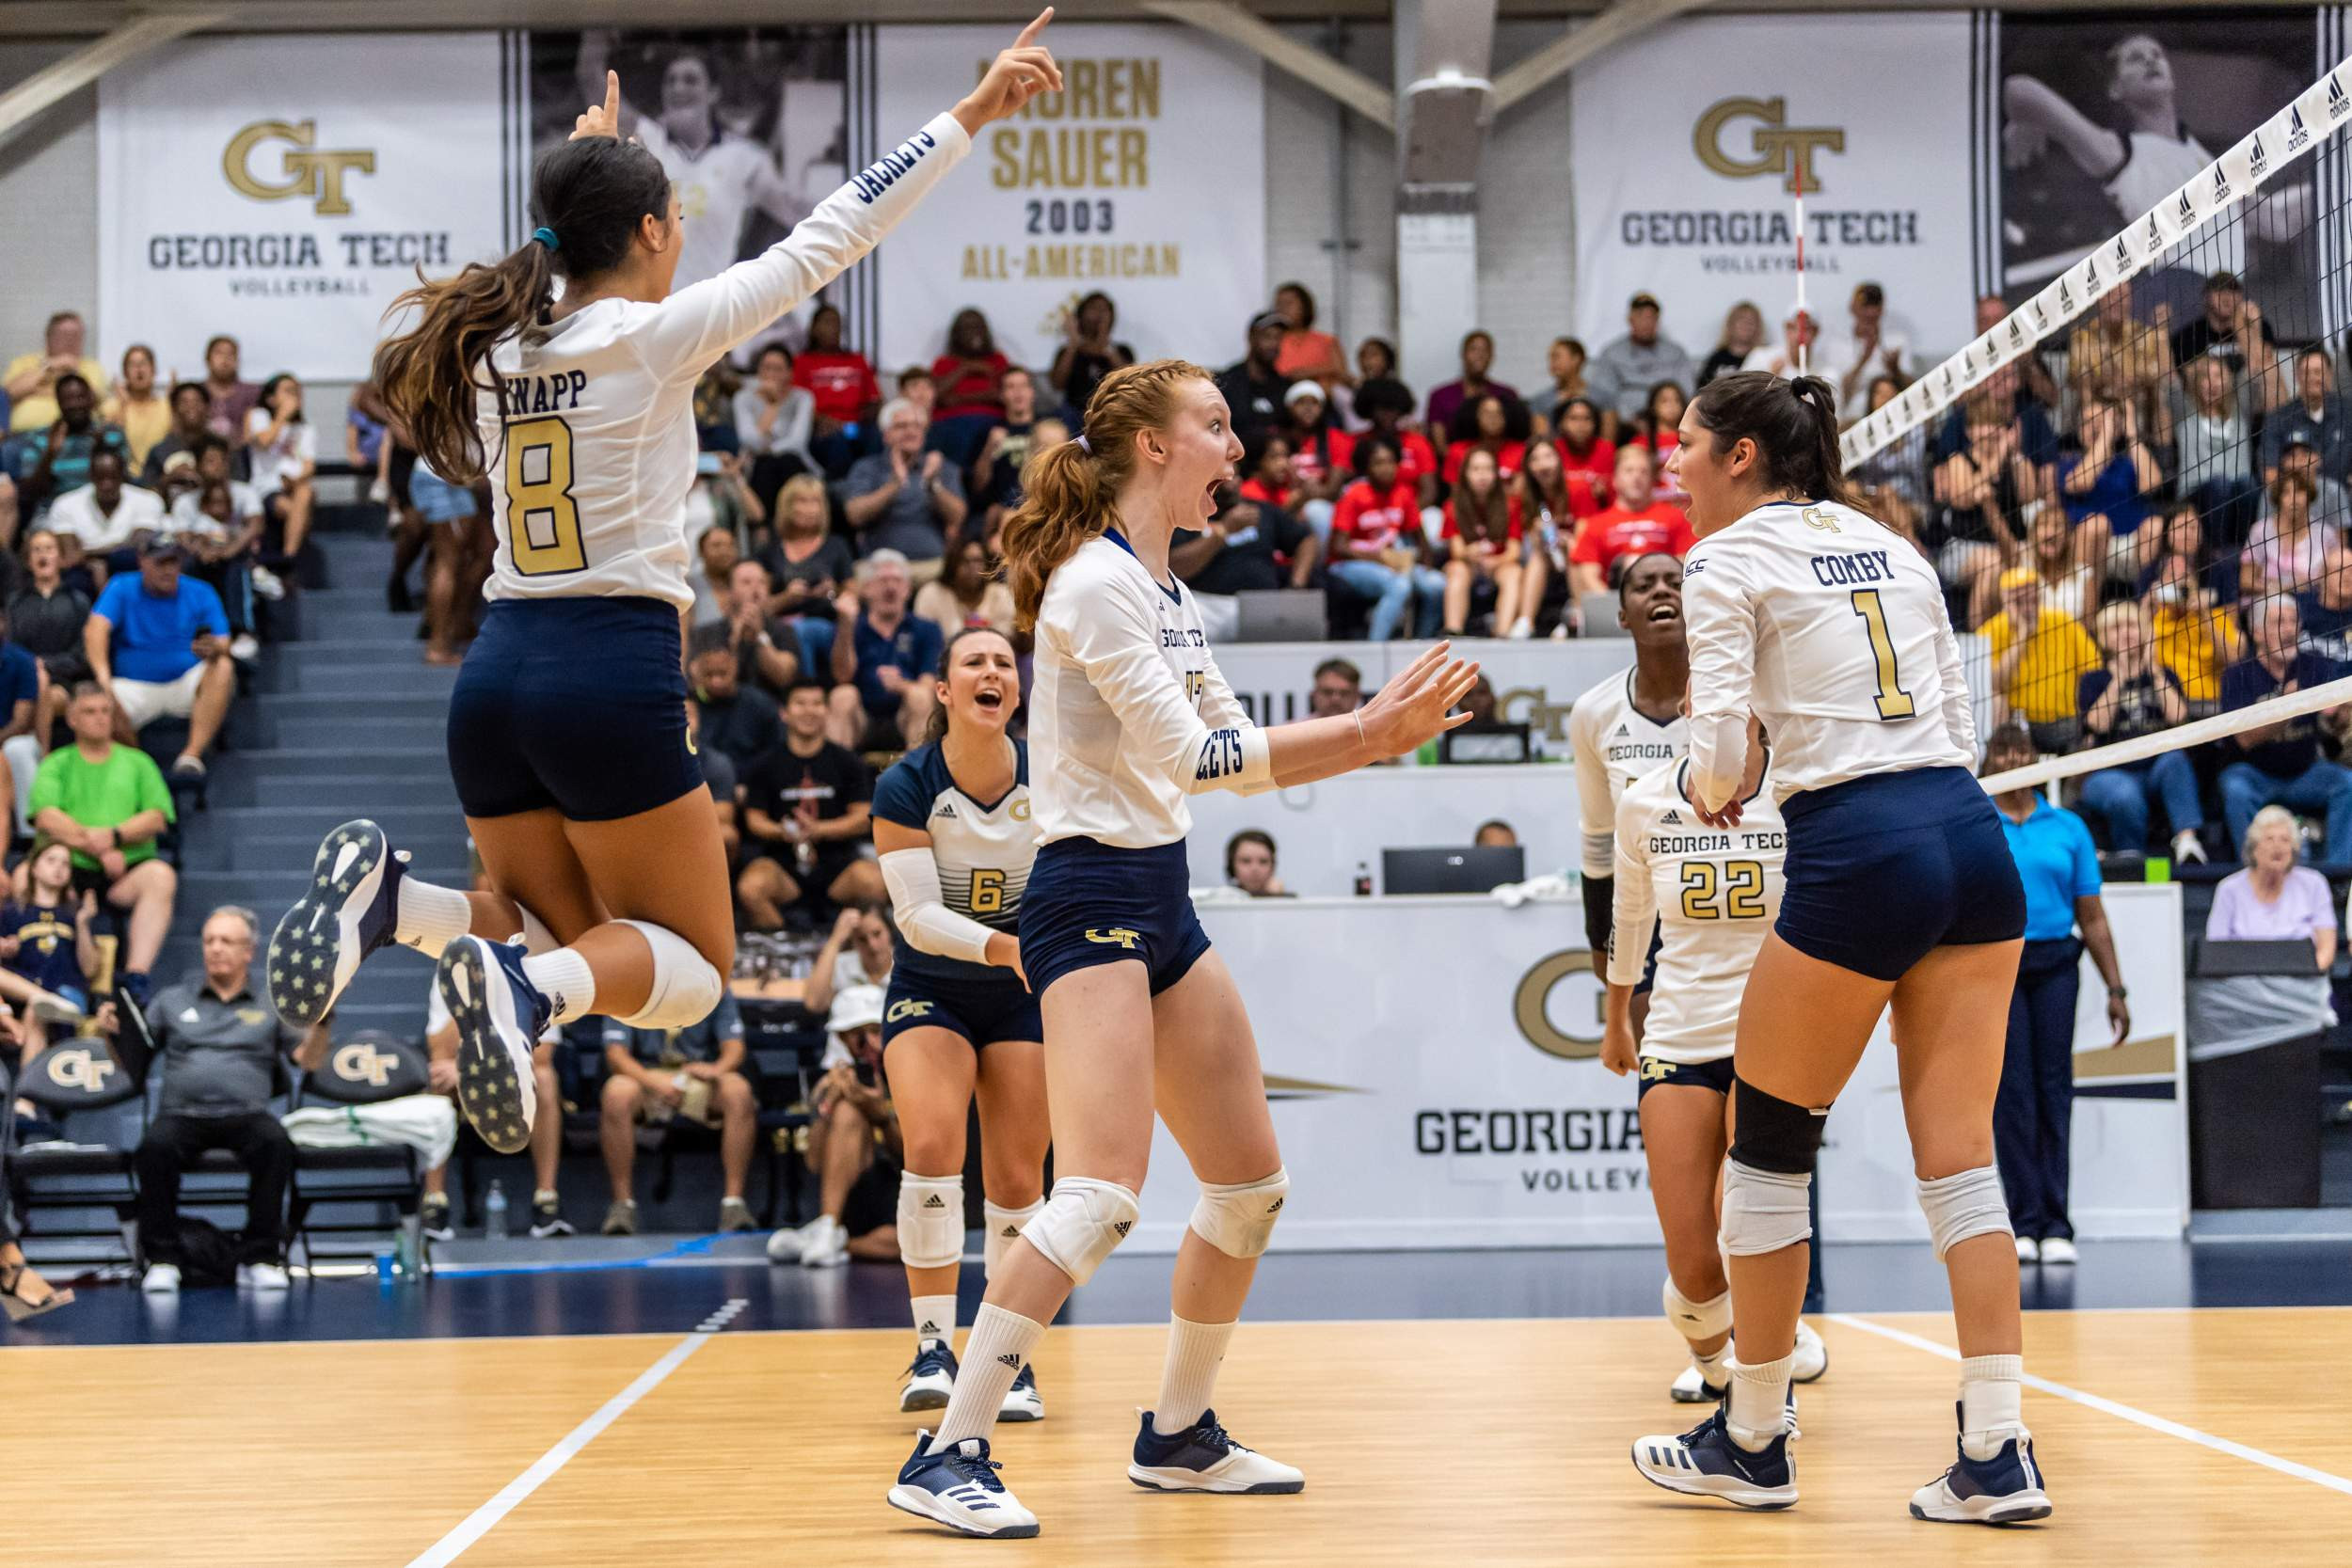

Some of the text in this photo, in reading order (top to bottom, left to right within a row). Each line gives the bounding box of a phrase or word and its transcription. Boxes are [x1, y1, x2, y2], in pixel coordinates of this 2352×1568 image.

[977, 58, 1161, 119] UREN
[2328, 97, 2350, 119] adidas
[991, 128, 1148, 188] SAUER
[1692, 95, 1846, 192] GT
[221, 119, 376, 215] GT
[1025, 198, 1114, 234] 2003
[1621, 210, 1917, 245] GEORGIA TECH
[148, 231, 451, 269] GEORGIA TECH
[961, 244, 1181, 279] ALL-AMERICAN
[229, 278, 372, 297] VOLLEYBALL
[505, 414, 588, 577] 8
[1802, 507, 1841, 533] GT
[1810, 550, 1896, 587] COMBY
[1851, 588, 1916, 721] 1
[1608, 744, 1674, 762] GEORGIA
[1009, 798, 1031, 822] G
[1649, 834, 1732, 854] GEORGIA
[969, 867, 1007, 914] 6
[1680, 860, 1766, 920] 22
[1513, 947, 1608, 1062] G
[47, 1049, 115, 1093] GT
[332, 1043, 400, 1086] GT
[1415, 1109, 1646, 1154] GEORGIA
[1521, 1169, 1653, 1193] VOLLEY
